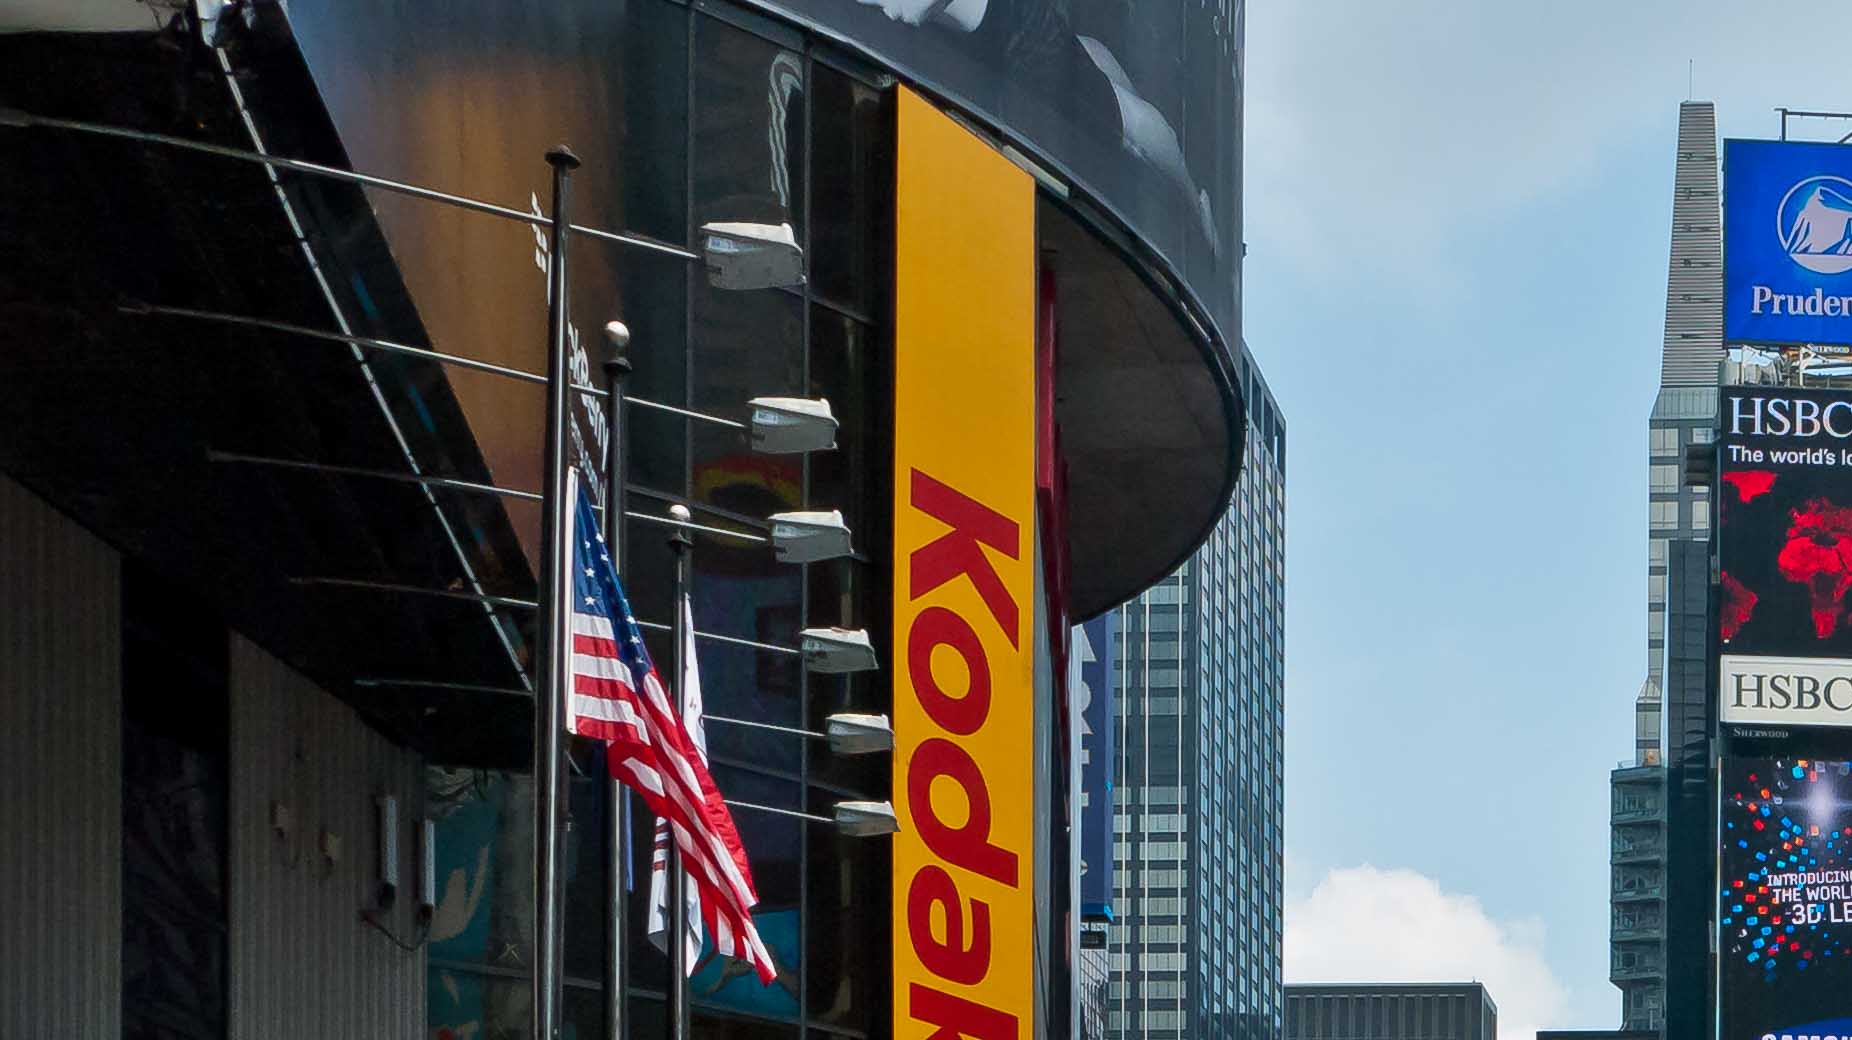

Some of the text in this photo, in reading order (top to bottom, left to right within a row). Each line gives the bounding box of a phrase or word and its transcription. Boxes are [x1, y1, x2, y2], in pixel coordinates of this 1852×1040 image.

[1728, 446, 1765, 464] The
[1770, 446, 1836, 466] world's
[1773, 887, 1801, 903] THE
[1791, 903, 1822, 925] 3D
